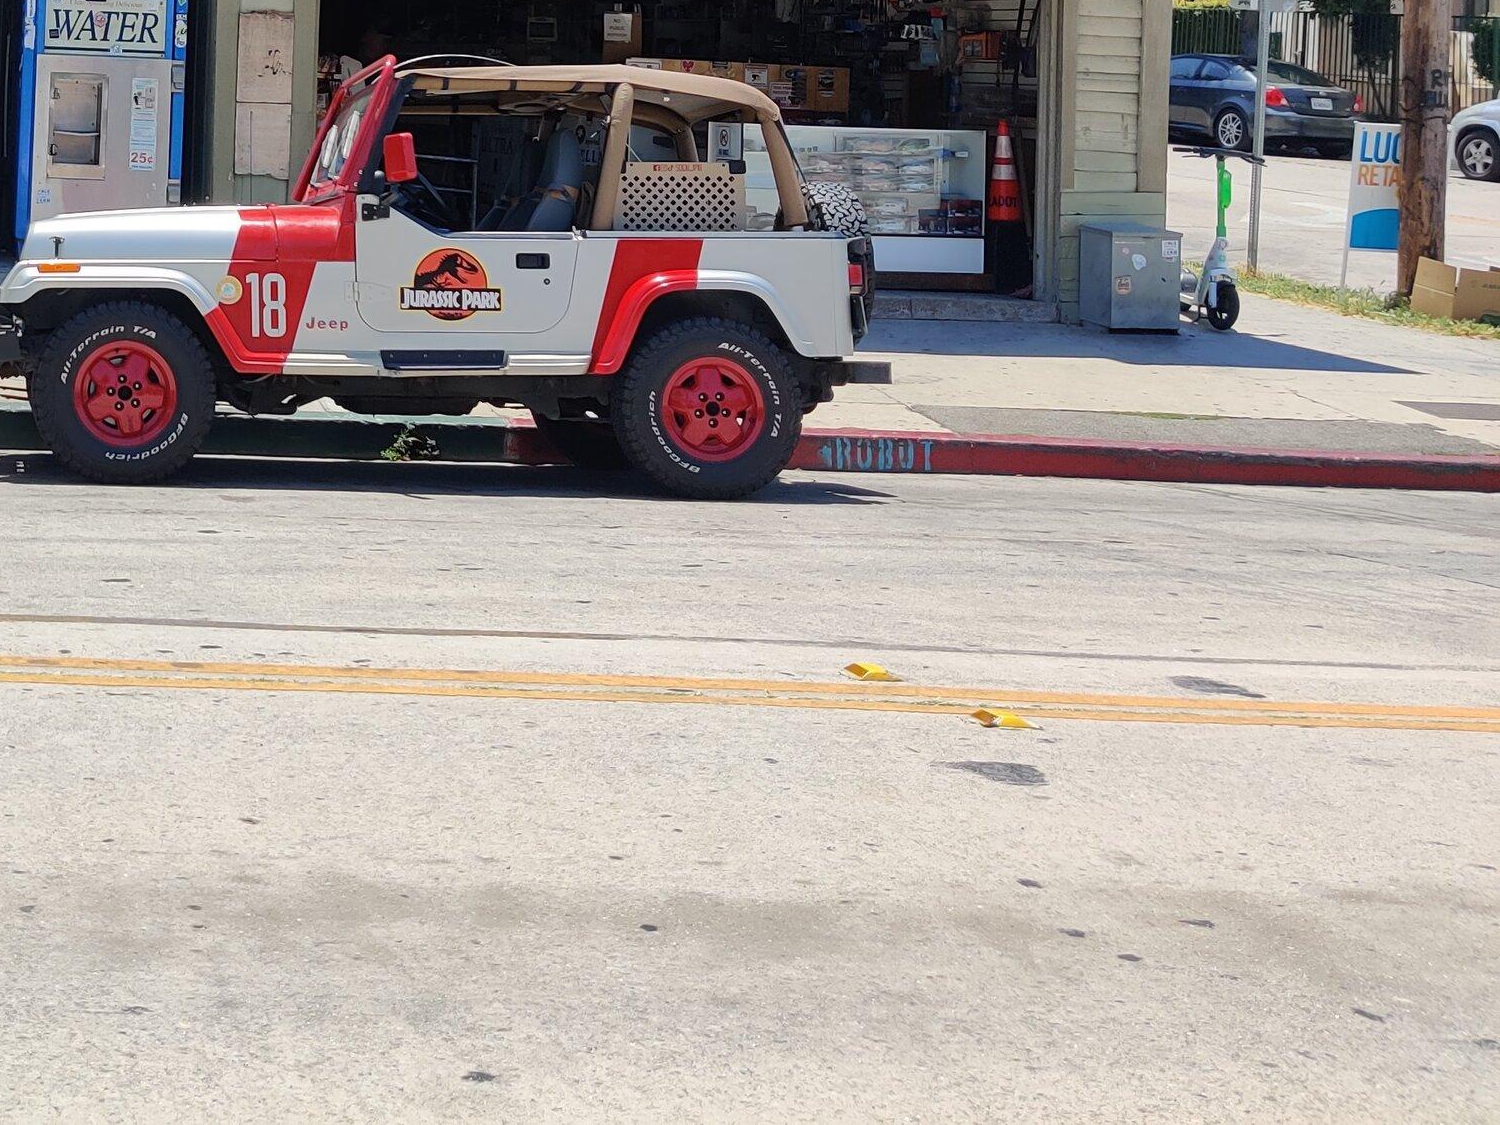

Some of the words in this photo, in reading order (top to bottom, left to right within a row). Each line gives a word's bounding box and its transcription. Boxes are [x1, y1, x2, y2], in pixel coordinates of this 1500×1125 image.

[53, 8, 159, 44] WATER
[245, 272, 287, 338] 18
[305, 316, 349, 331] Jeep
[400, 288, 461, 309] JURASSIC
[461, 288, 501, 311] PARK
[60, 325, 125, 385] All-Terrain
[132, 325, 157, 340] T/A
[717, 342, 781, 405] All-Terrain
[770, 413, 782, 439] T/A
[105, 412, 189, 462] BFGoodrich
[648, 390, 701, 474] BFGoodrich
